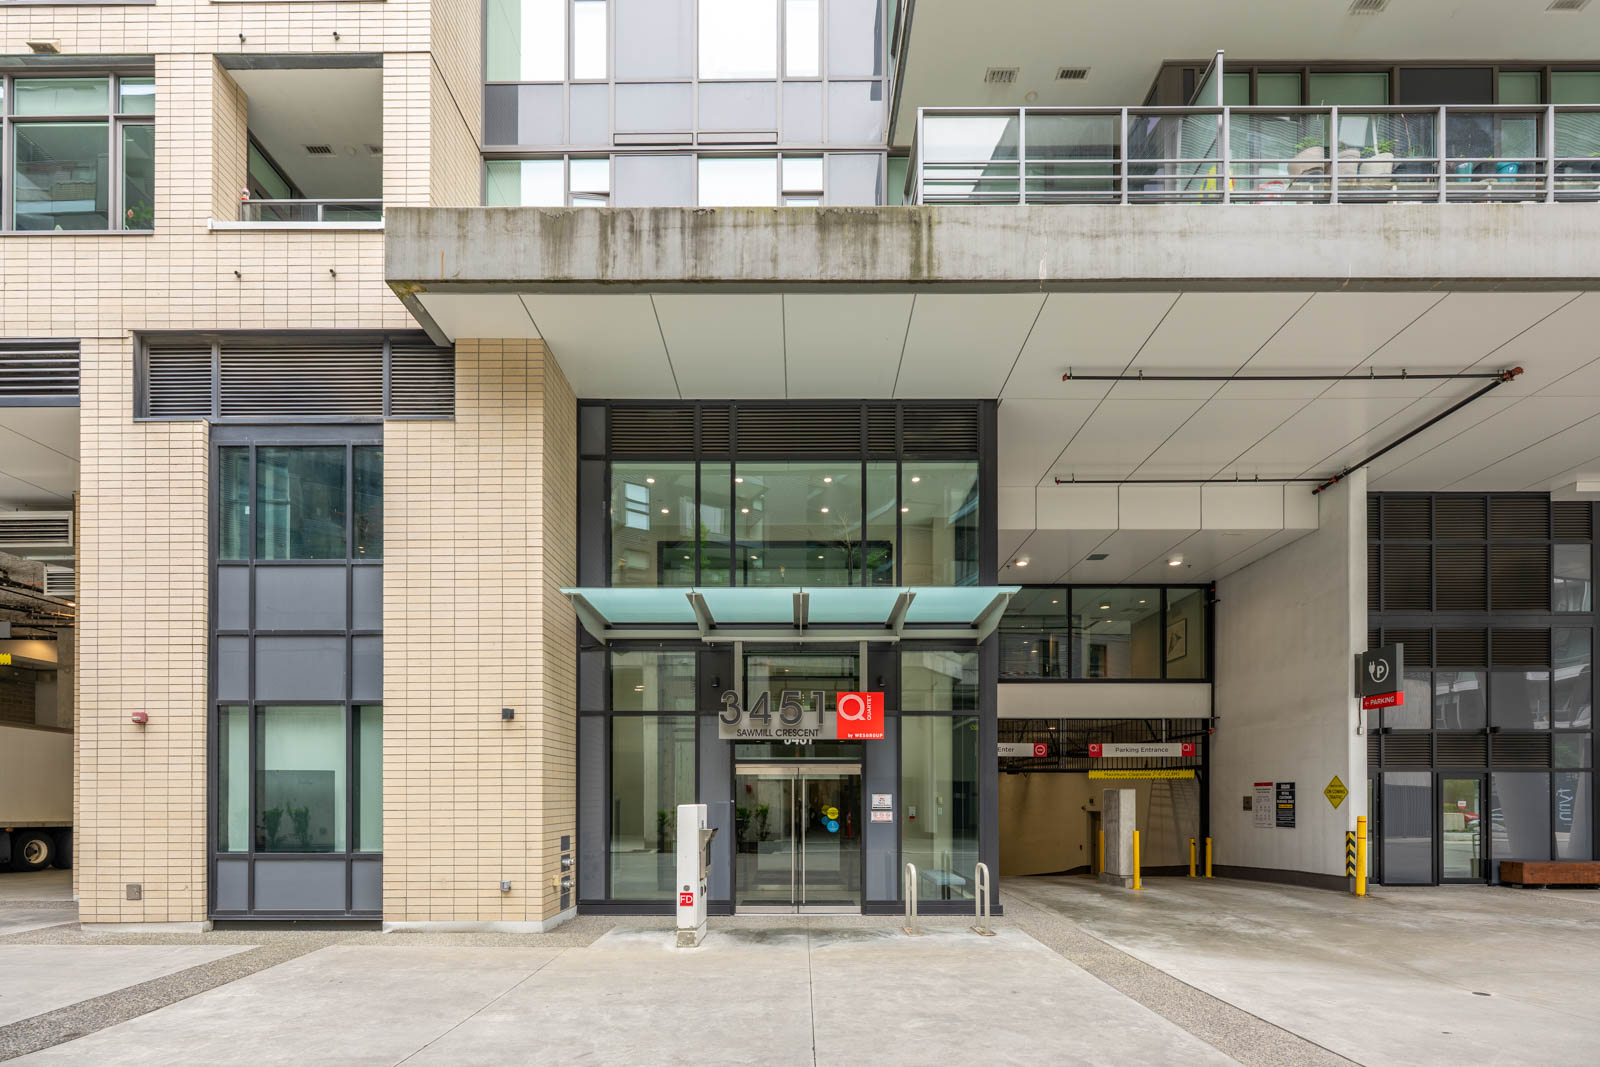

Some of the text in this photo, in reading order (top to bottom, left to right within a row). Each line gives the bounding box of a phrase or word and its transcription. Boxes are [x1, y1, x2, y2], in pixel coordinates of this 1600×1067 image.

[1370, 695, 1395, 705] PARKING
[719, 690, 826, 726] 3451
[838, 694, 866, 721] Q
[736, 728, 820, 737] SAWMILL CRESCENT
[680, 895, 693, 904] FD
